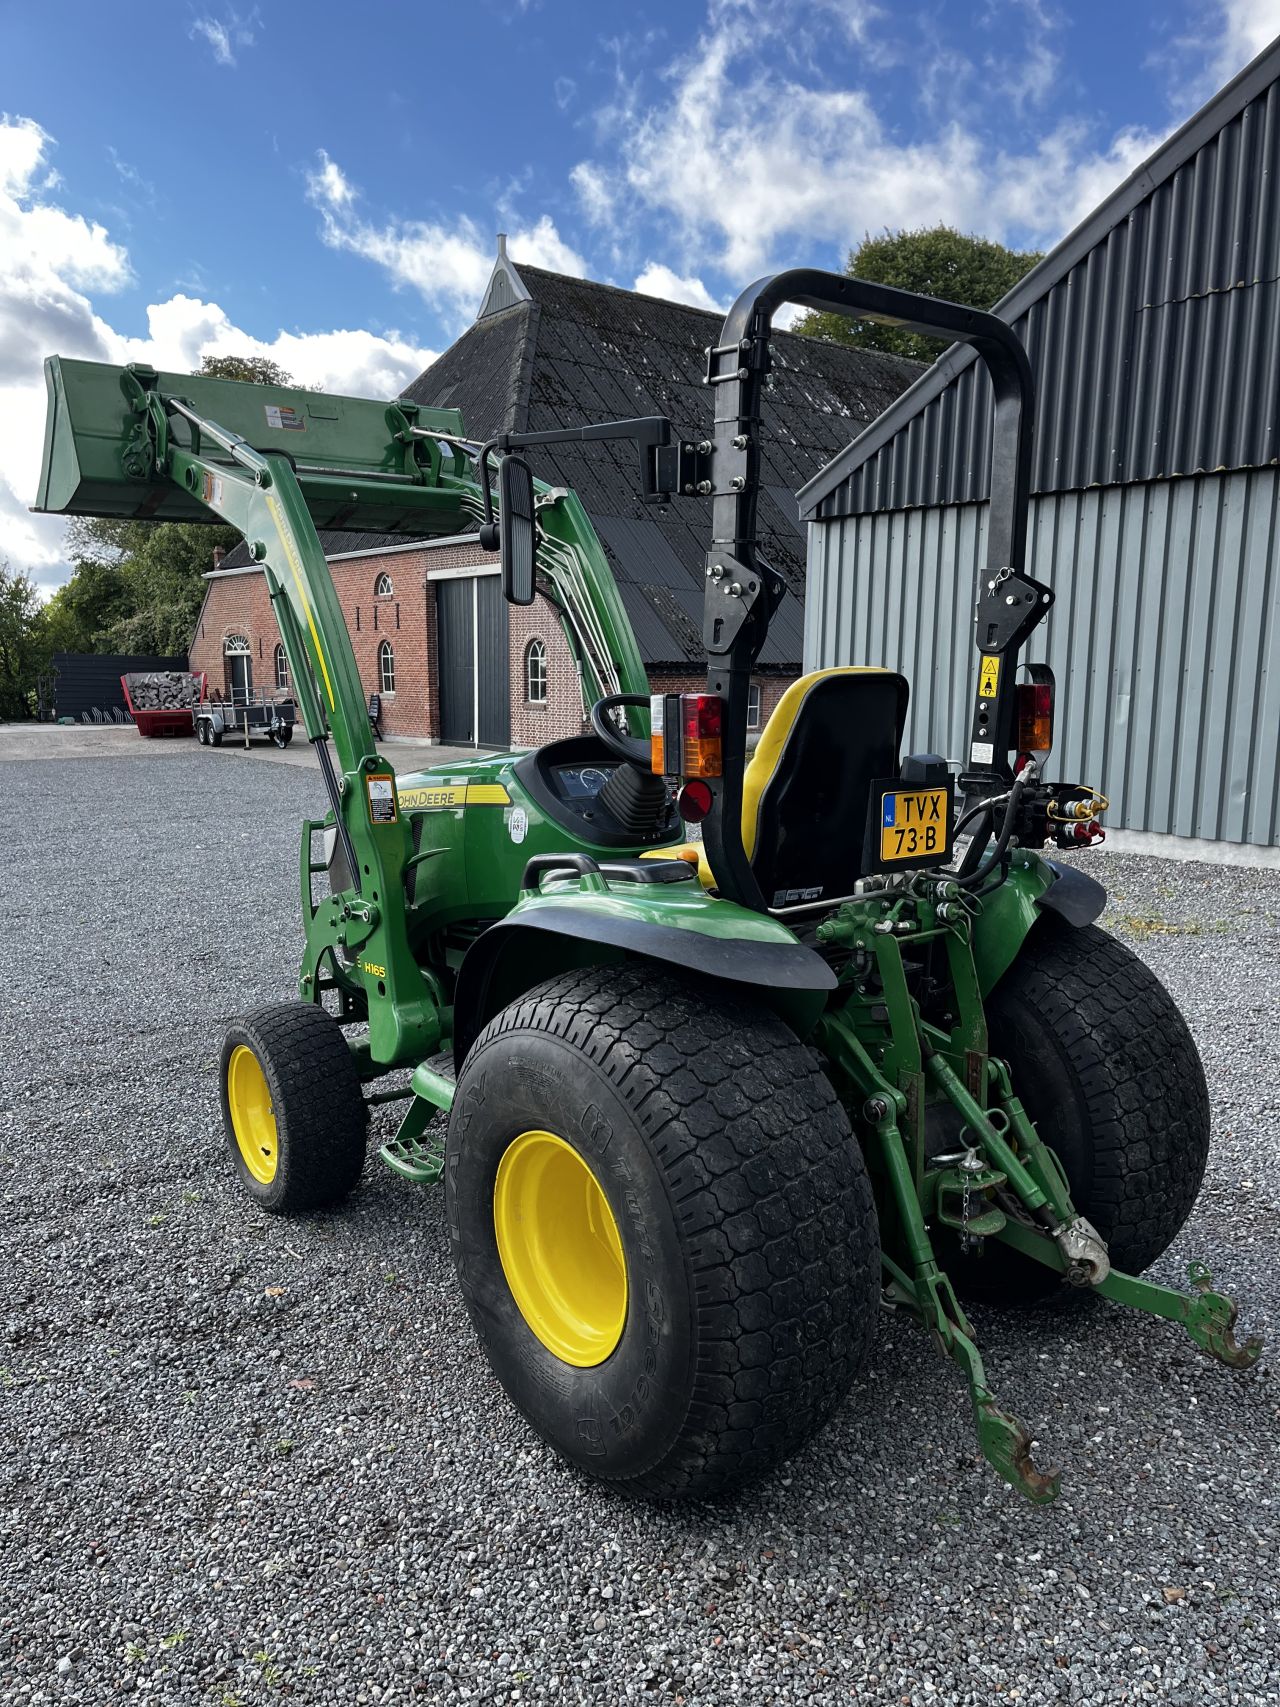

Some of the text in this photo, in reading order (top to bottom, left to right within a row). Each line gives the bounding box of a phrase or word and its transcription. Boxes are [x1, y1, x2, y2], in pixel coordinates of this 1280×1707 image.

[398, 791, 455, 807] OHN DEERE
[903, 794, 941, 823] TVX
[885, 814, 893, 822] NL
[894, 825, 937, 855] 73-B
[364, 961, 386, 978] H165
